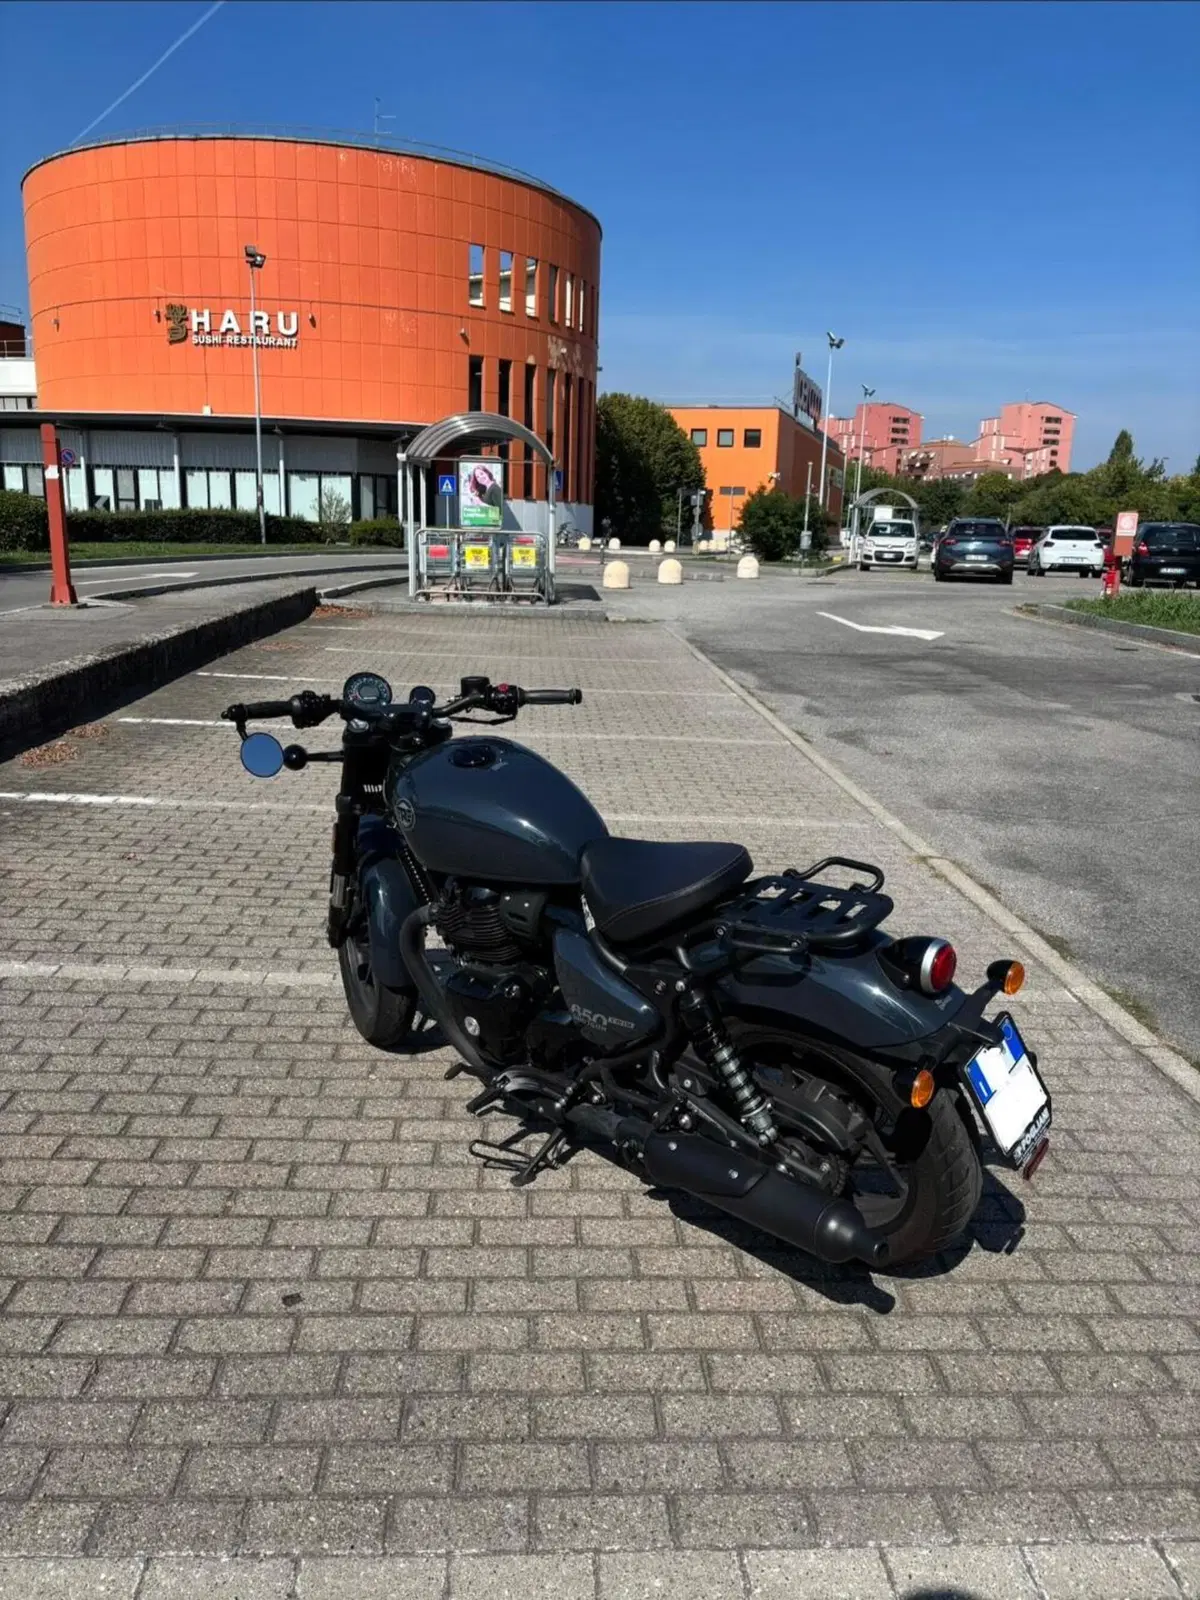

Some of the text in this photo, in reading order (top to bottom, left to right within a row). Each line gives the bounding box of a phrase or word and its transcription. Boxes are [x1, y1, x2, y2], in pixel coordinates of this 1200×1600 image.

[191, 308, 298, 335] HARU
[191, 334, 298, 347] SUSHI RESTAURANT
